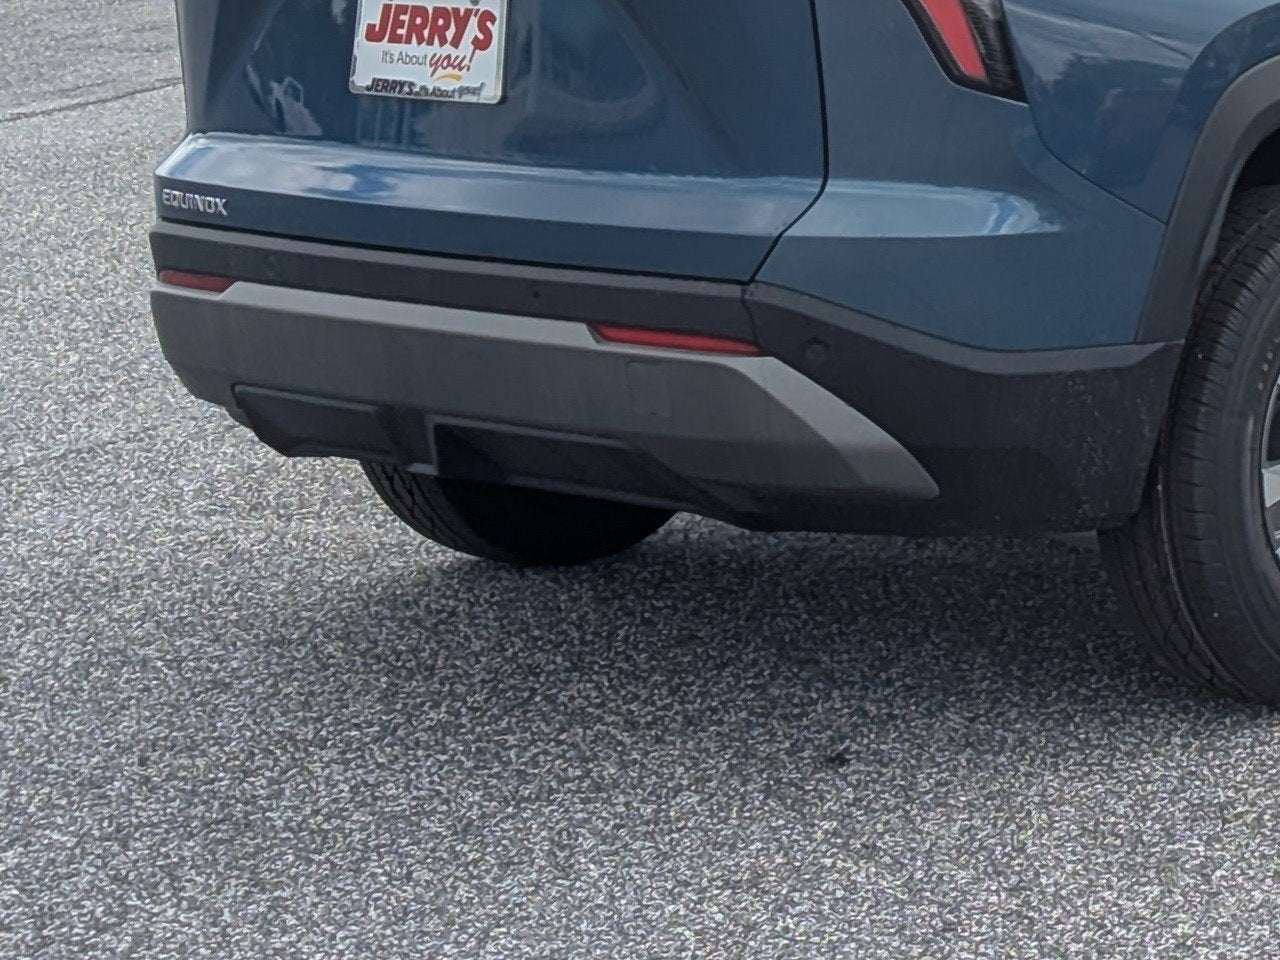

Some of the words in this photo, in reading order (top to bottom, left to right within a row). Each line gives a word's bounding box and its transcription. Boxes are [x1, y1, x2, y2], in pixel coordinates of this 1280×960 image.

[364, 3, 497, 51] JERRY'S
[381, 50, 395, 64] It's
[396, 51, 428, 66] About
[428, 48, 477, 77] you!
[365, 77, 416, 96] JERRY'S
[162, 188, 228, 216] EQUINOX
